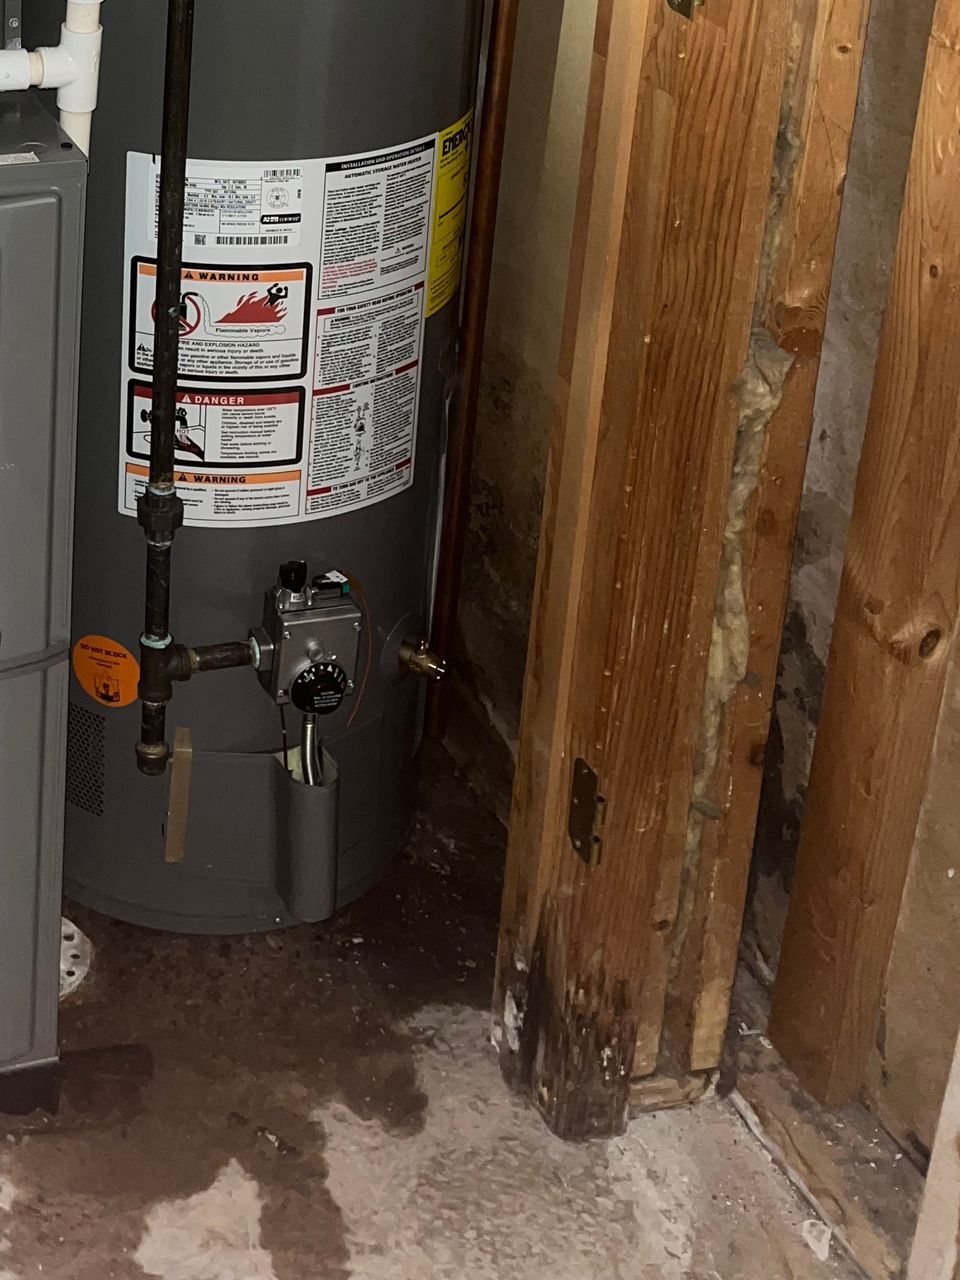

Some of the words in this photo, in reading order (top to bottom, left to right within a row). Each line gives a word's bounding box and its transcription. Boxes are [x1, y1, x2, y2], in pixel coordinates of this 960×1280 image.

[199, 272, 260, 281] WARNING
[250, 327, 271, 335] Vapors
[195, 395, 244, 405] DANGER
[194, 475, 246, 483] WARNING
[90, 646, 103, 654] NOT
